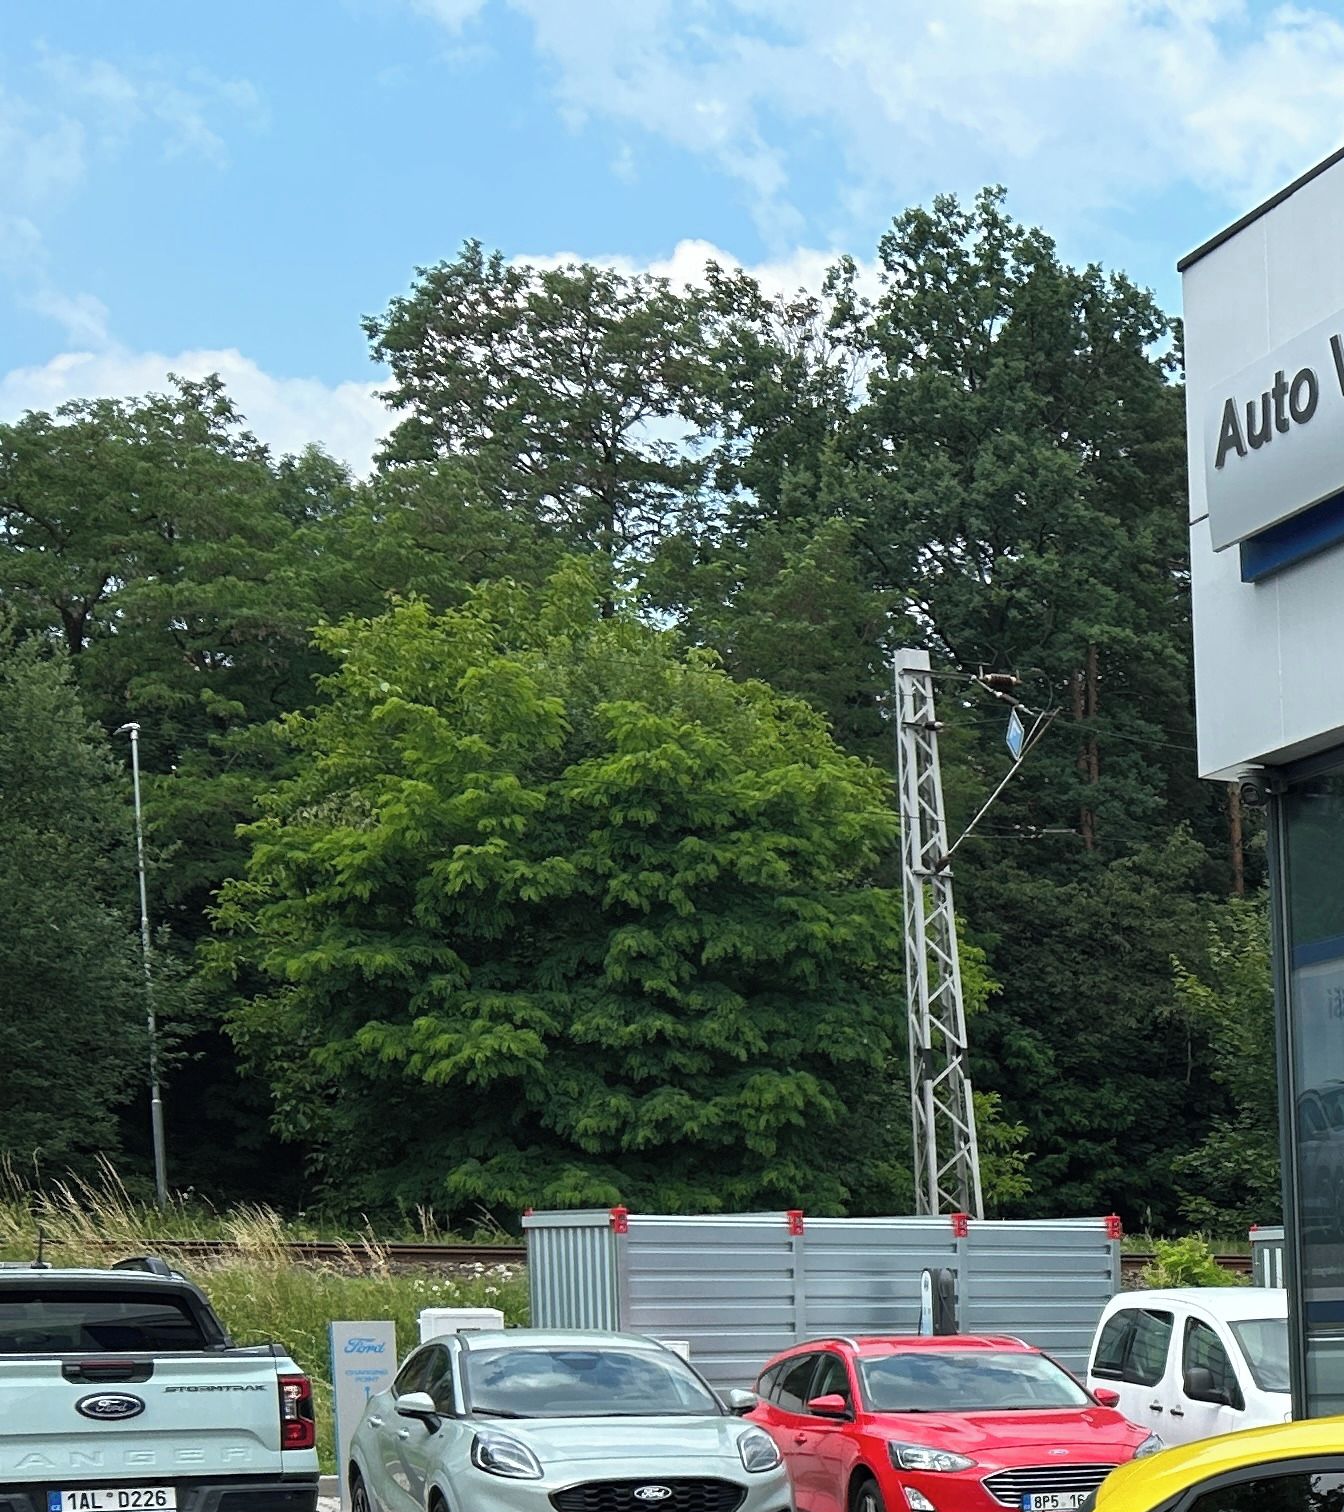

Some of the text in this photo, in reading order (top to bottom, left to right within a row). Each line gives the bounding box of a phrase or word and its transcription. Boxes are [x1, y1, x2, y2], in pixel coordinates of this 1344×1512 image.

[1215, 367, 1319, 470] Auto
[344, 1336, 385, 1353] Ford
[163, 1384, 270, 1393] STORMTRAK
[96, 1399, 128, 1412] Ford
[67, 1490, 167, 1510] 1AL D226
[1034, 1495, 1059, 1509] 8P5
